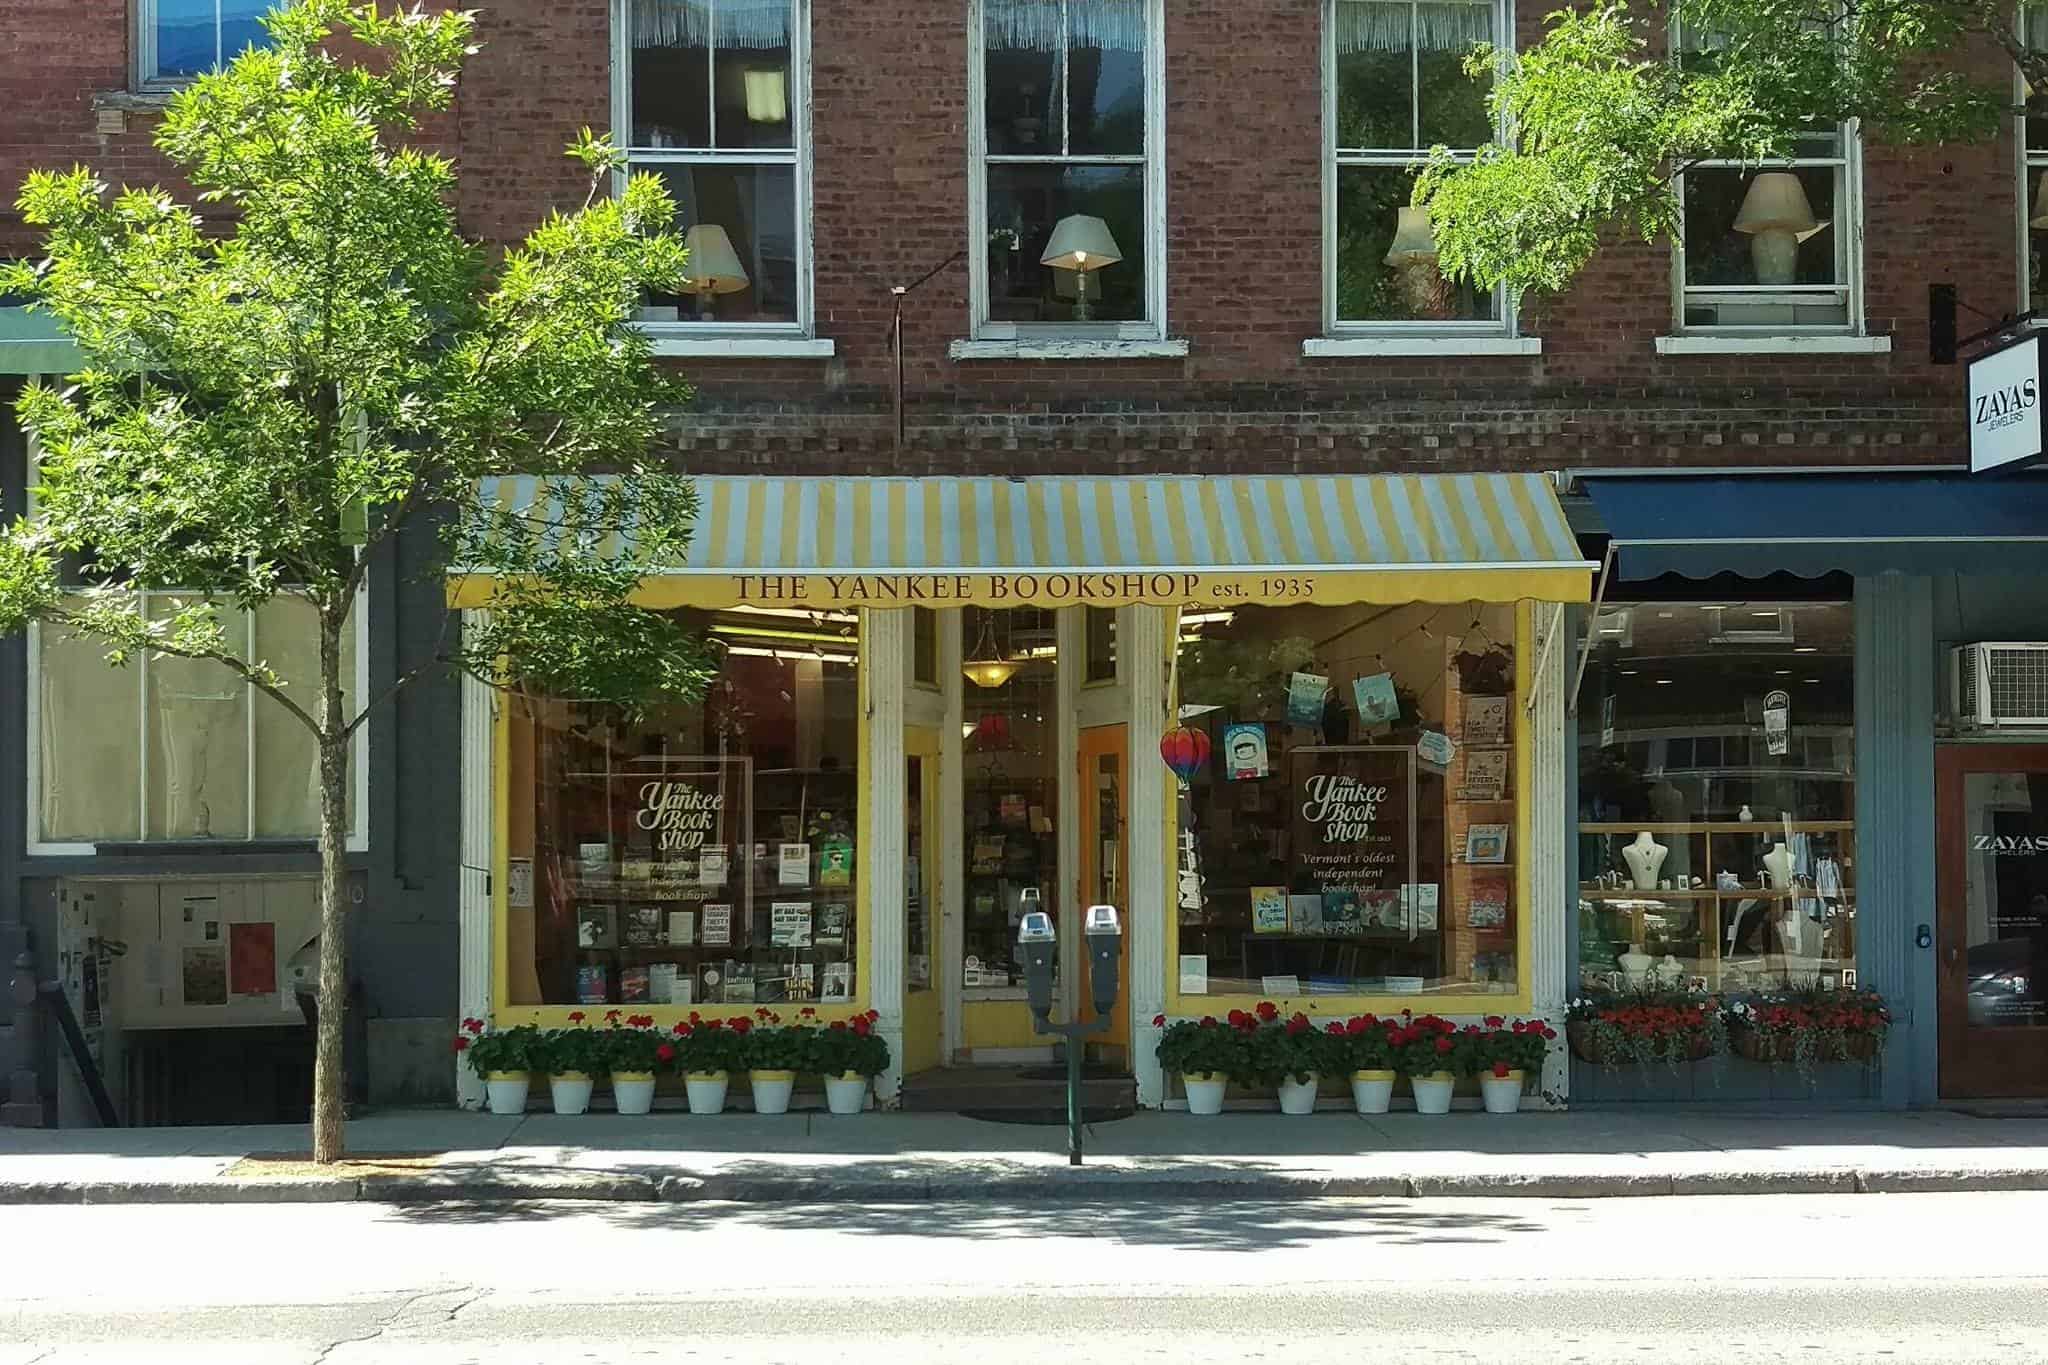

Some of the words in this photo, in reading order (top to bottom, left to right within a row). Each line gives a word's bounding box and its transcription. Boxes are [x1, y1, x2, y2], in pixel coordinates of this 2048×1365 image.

[1976, 378, 2036, 424] ZAYAS
[1988, 410, 2024, 432] JEWELERS
[733, 575, 808, 599] THE
[826, 575, 972, 599] YANKEE
[989, 574, 1200, 599] BOOKSHOP
[1212, 582, 1249, 597] est.
[1261, 578, 1314, 597] 1935
[672, 782, 694, 794] The
[1339, 775, 1358, 786] The
[636, 782, 723, 830] Yankee
[1303, 775, 1388, 822] Yankee
[660, 810, 713, 830] Book
[1327, 802, 1377, 821] Book
[658, 829, 704, 850] shop
[1322, 821, 1369, 842] shop
[1973, 835, 2048, 851] ZAYAS
[1362, 851, 1396, 864] oldest
[1313, 867, 1384, 881] independent
